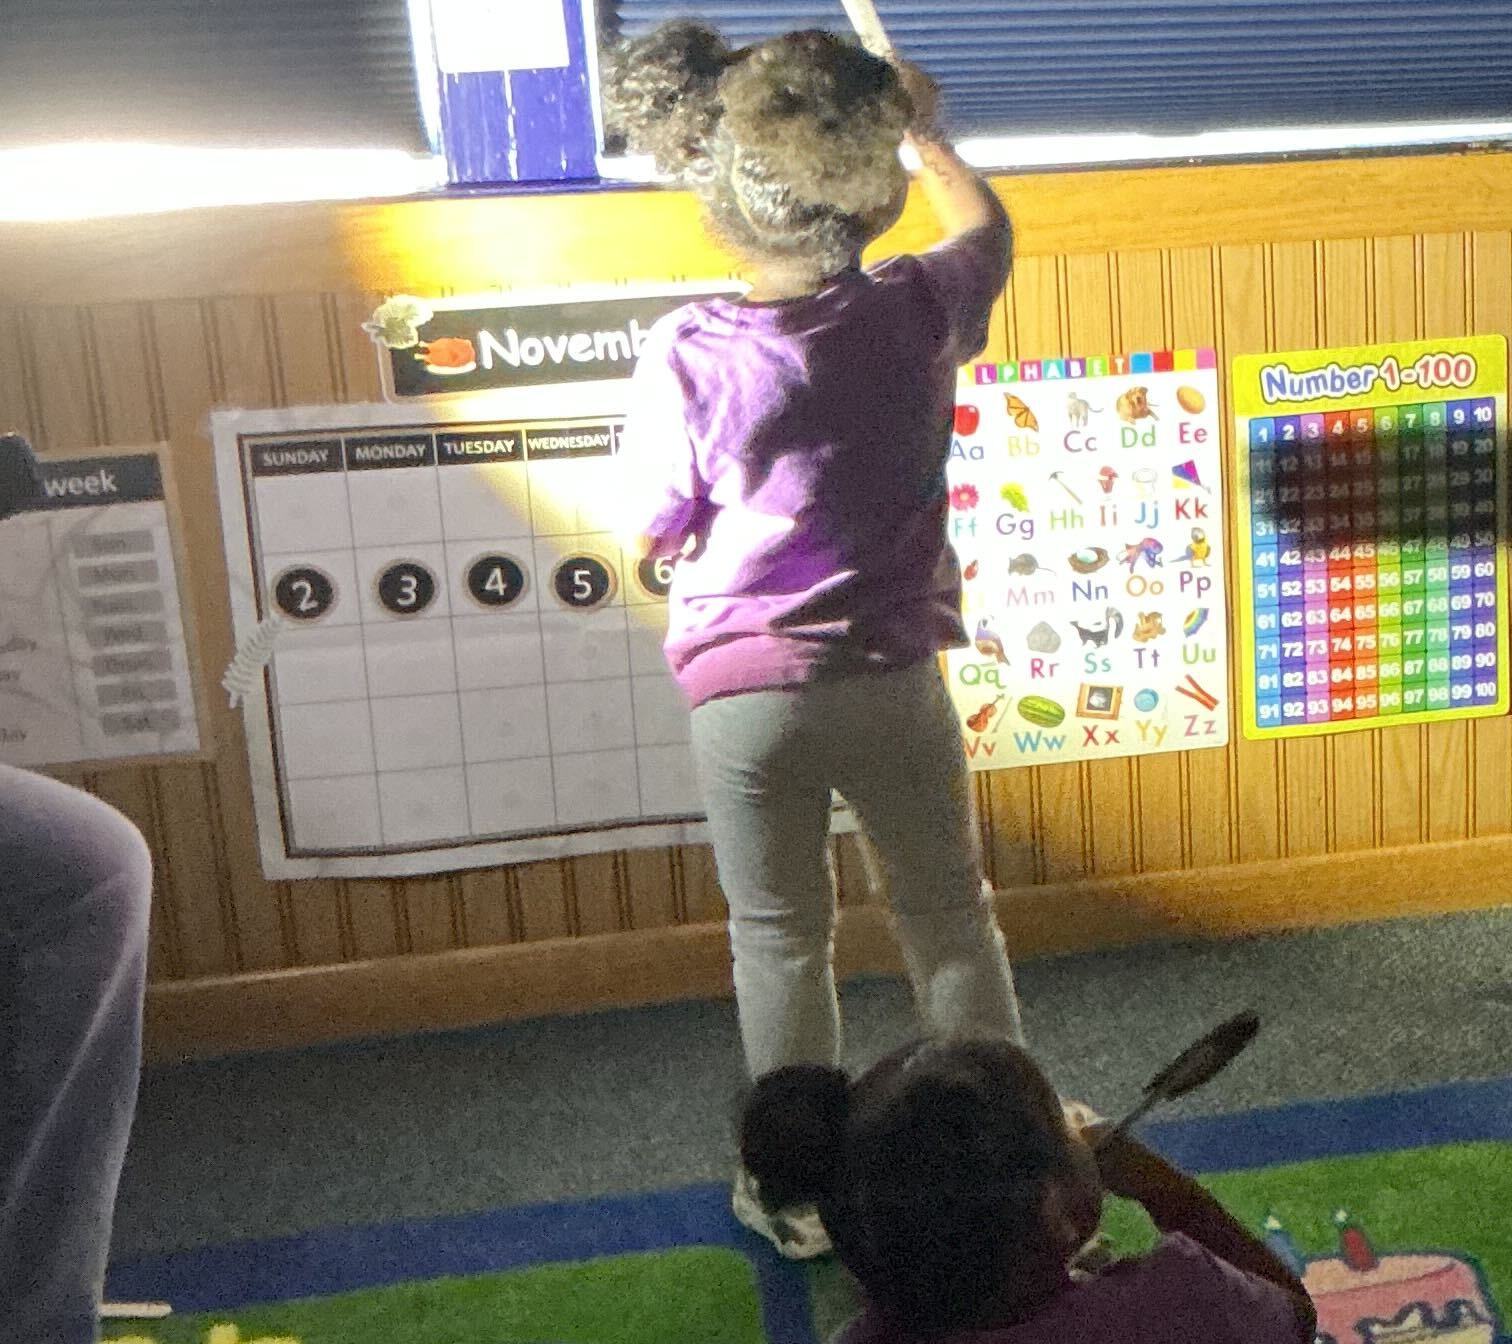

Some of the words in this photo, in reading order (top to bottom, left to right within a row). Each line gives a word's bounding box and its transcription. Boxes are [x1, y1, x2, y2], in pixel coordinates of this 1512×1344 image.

[478, 317, 652, 370] Novemb
[964, 358, 1125, 380] LPHABET
[1263, 364, 1377, 400] Number
[951, 440, 984, 460] Aa
[1008, 435, 1040, 457] Bb
[1064, 430, 1097, 452] Cc
[1121, 424, 1156, 448] Dd
[1179, 422, 1208, 444] Ee
[1258, 428, 1268, 442] 1
[1283, 425, 1294, 440] 2
[1308, 423, 1319, 438] 3
[1332, 420, 1344, 435] 4
[1357, 417, 1368, 433] 5
[1381, 416, 1392, 431] 6
[1406, 414, 1416, 428] 7
[1430, 411, 1440, 426] 8
[1453, 409, 1464, 424] 9
[1474, 407, 1492, 422] 10
[262, 449, 329, 467] SUNDAY
[355, 443, 426, 461] MONDAY
[444, 439, 515, 456] TUESDAY
[527, 433, 611, 452] WEDNESDAY
[44, 469, 118, 497] week
[954, 517, 976, 537] Ff
[996, 513, 1034, 540] Gg
[1051, 510, 1084, 530] Hh
[1099, 505, 1117, 527] Ii
[1135, 501, 1159, 528] Jj
[1175, 497, 1208, 520] Kk
[296, 580, 318, 611] 2
[397, 574, 418, 606] 3
[484, 567, 508, 596] 4
[573, 569, 593, 600] 5
[653, 556, 674, 584] 6
[1007, 586, 1054, 607] Mm
[1072, 580, 1108, 602] Nn
[1126, 575, 1164, 597] Oo
[1180, 571, 1211, 598] Pp
[1257, 584, 1276, 598] 51
[1282, 582, 1301, 596] 52
[1306, 579, 1326, 593] 53
[1330, 577, 1351, 591] 54
[1355, 575, 1375, 589] 55
[1379, 572, 1399, 587] 56
[1404, 570, 1423, 584] 57
[1451, 565, 1471, 579] 59
[1475, 562, 1494, 577] 60
[1258, 615, 1277, 629] 61
[1282, 612, 1302, 627] 62
[1306, 610, 1326, 624] 63
[1330, 607, 1351, 621] 64
[1355, 605, 1375, 620] 65
[1379, 603, 1399, 617] 66
[1403, 600, 1423, 614] 67
[1451, 595, 1471, 610] 69
[1476, 592, 1495, 606] 70
[1258, 645, 1277, 659] 71
[1283, 643, 1303, 657] 72
[1308, 640, 1327, 654] 73
[1333, 637, 1352, 651] 74
[1356, 635, 1375, 649] 75
[1380, 634, 1399, 648] 76
[1404, 630, 1424, 644] 77
[1452, 625, 1471, 639] 79
[1476, 652, 1495, 667] 90
[960, 663, 1006, 689] Qq
[1031, 658, 1060, 679] Rr
[1084, 653, 1111, 674] Ss
[1134, 648, 1160, 669] Tt
[1183, 644, 1216, 664] Uu
[1260, 704, 1280, 718] 91
[1284, 703, 1304, 717] 92
[1308, 700, 1328, 714] 93
[1332, 697, 1352, 712] 94
[1356, 694, 1376, 709] 95
[1379, 691, 1399, 706] 96
[1404, 690, 1424, 704] 97
[1452, 685, 1472, 699] 99
[1475, 683, 1496, 696] 100
[964, 736, 996, 759] Vv
[1014, 730, 1066, 753] Ww
[1083, 724, 1119, 747] Xx
[1136, 720, 1167, 746] Yy
[1184, 715, 1216, 737] Zz
